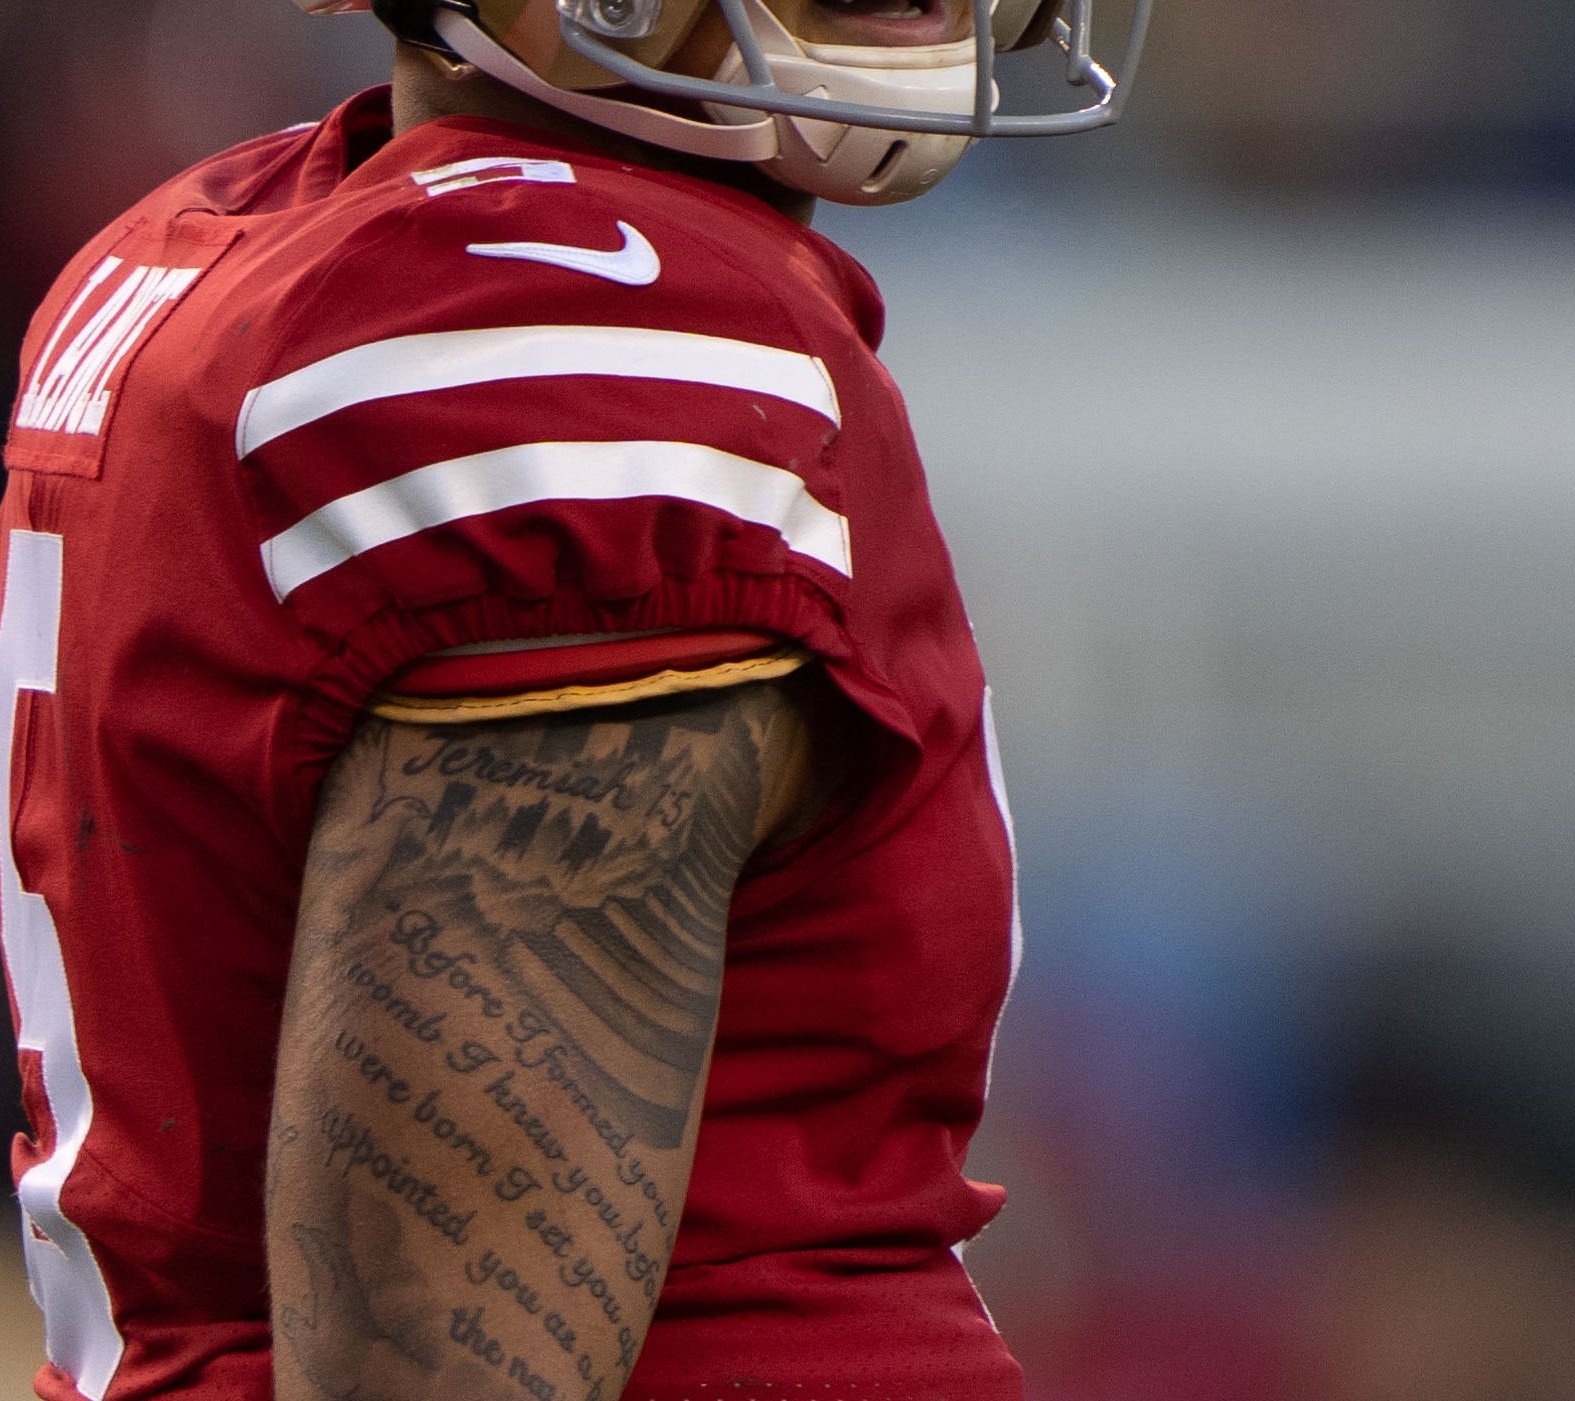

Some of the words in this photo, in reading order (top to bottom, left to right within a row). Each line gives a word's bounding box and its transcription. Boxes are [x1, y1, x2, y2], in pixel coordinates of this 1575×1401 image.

[403, 734, 641, 808] Jeremiah
[347, 962, 445, 1044] womb
[485, 1071, 569, 1165] knew
[515, 1043, 634, 1163] formed
[317, 1108, 477, 1244] appointed
[464, 1248, 544, 1316] you
[334, 1030, 410, 1106] were
[413, 1090, 496, 1176] born
[557, 1255, 625, 1320] you
[447, 1306, 506, 1368] the
